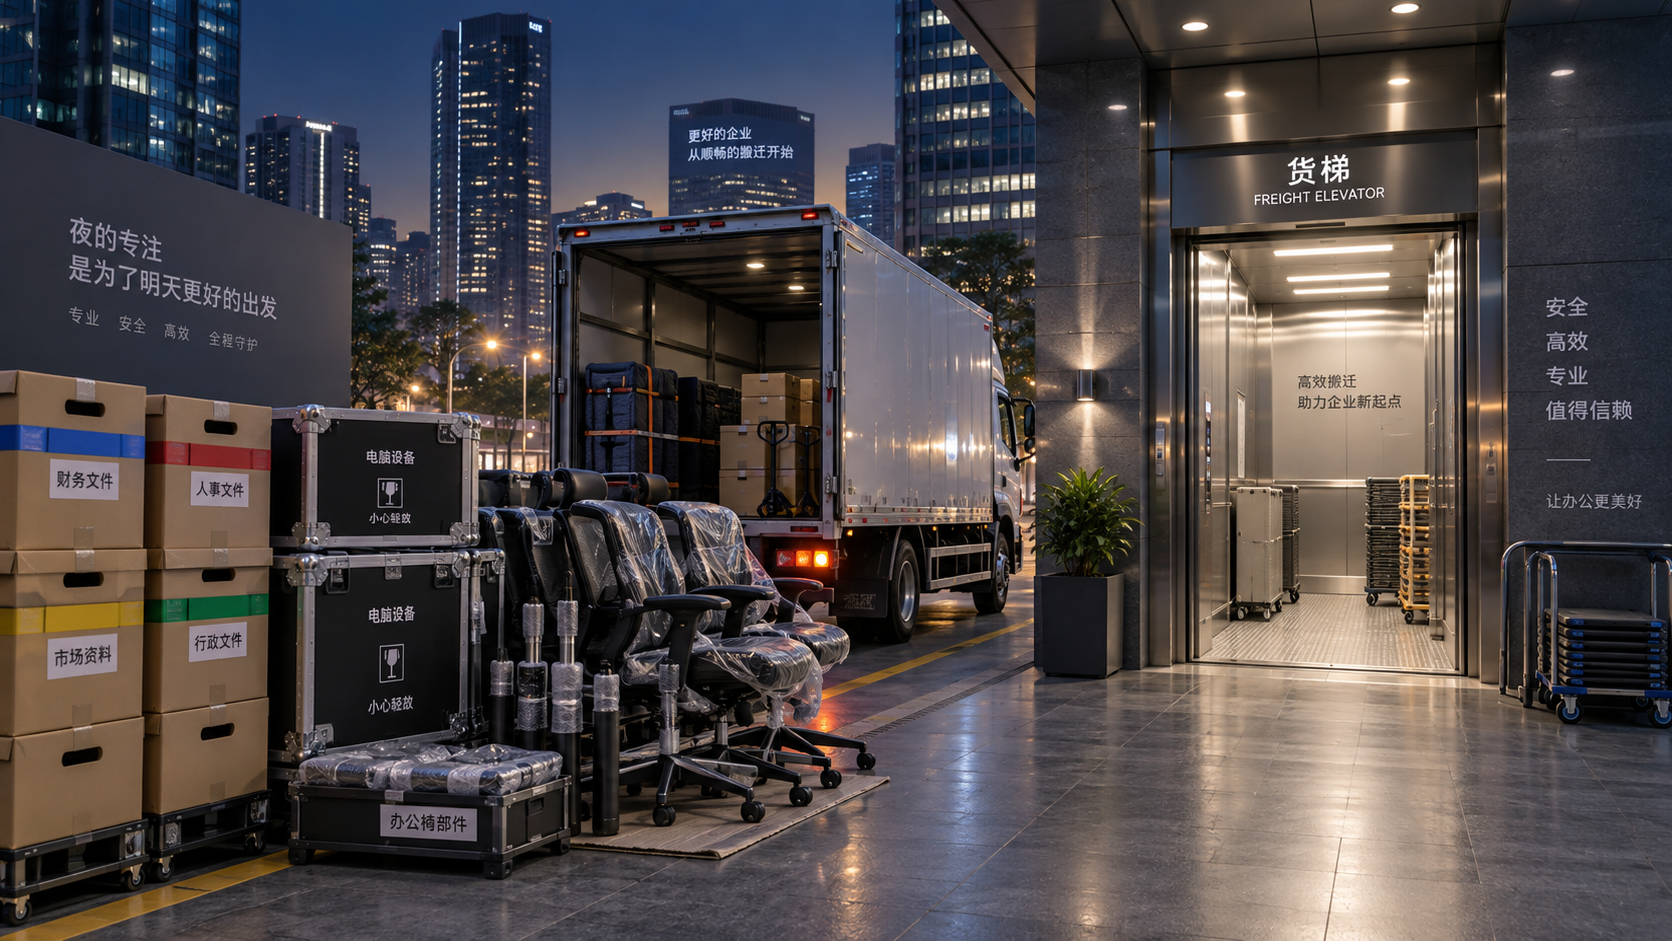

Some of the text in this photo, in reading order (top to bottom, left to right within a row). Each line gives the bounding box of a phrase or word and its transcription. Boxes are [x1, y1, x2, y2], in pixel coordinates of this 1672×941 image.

[689, 127, 751, 143] 更好的企业
[1288, 154, 1349, 186] 货梯
[1255, 187, 1384, 205] FREIGHT ELEVATOR
[69, 217, 163, 265] 夜的专注
[69, 254, 278, 321] 是为了明天更好的出发
[1546, 296, 1588, 317] 安全
[69, 307, 257, 351] 专业 安全 高效 全程守护
[1546, 331, 1588, 352] 高效
[1298, 374, 1356, 389] 高效搬迁
[1546, 366, 1588, 386] 专业
[1298, 394, 1401, 409] 助力企业新起点
[1546, 400, 1632, 420] 值得信赖
[57, 471, 113, 489] 财务文件
[197, 481, 244, 497] 人事文件
[1547, 494, 1641, 509] 让办公更美好
[195, 632, 242, 651] 行政文件
[55, 645, 111, 667] 市场资料
